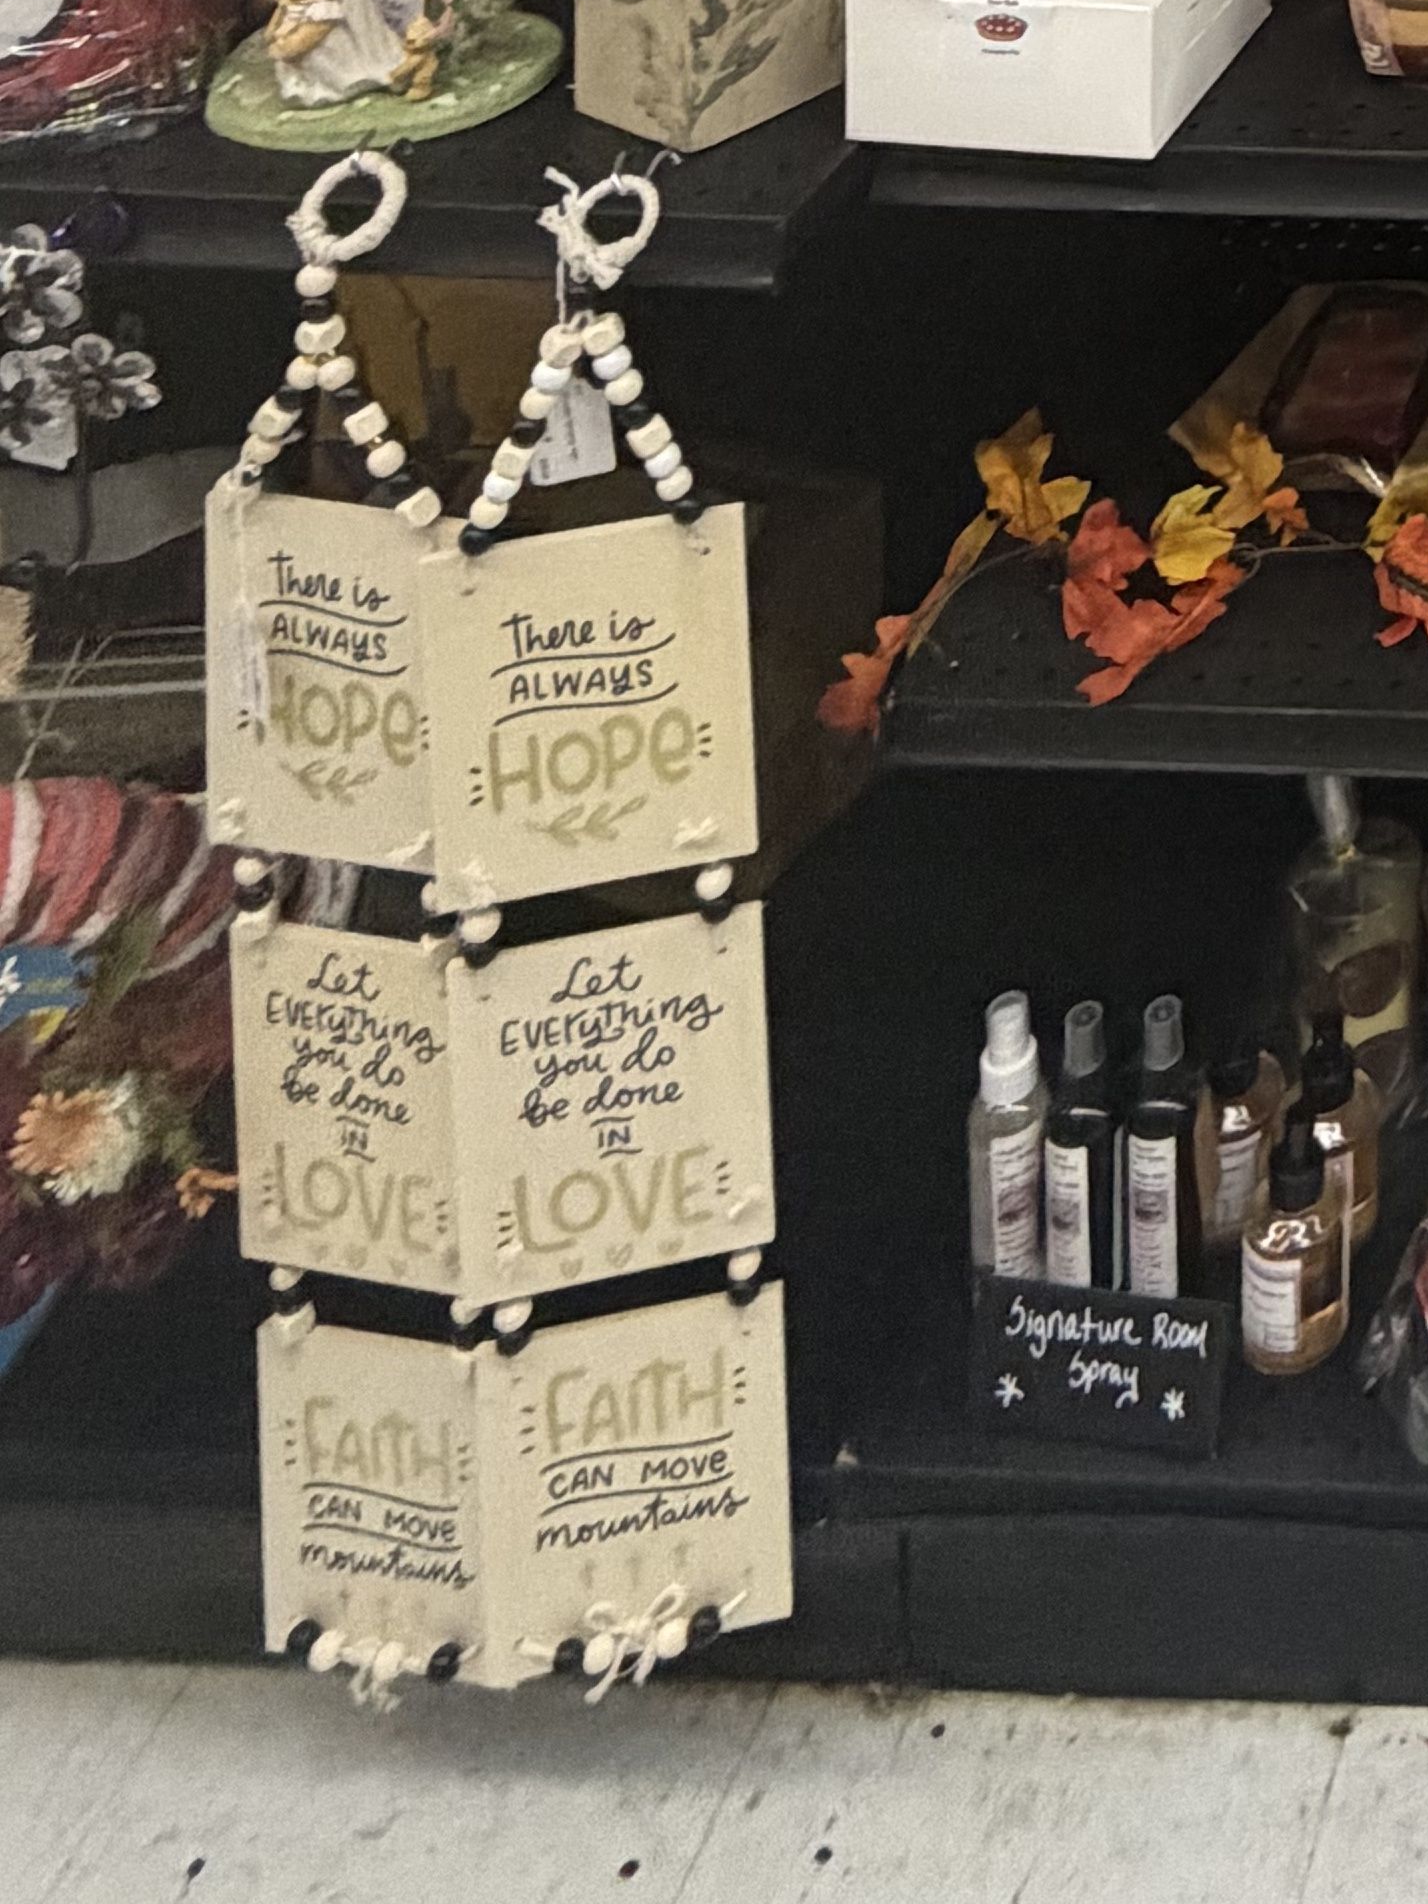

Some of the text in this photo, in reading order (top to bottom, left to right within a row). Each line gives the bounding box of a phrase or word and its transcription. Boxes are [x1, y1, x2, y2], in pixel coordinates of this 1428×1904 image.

[268, 550, 391, 610] There is
[271, 611, 388, 662] ALWAYS
[502, 610, 655, 661] There is
[510, 661, 653, 703] ALWAYS
[307, 953, 380, 1001] Let
[551, 953, 642, 1004] Let
[293, 1035, 405, 1087] you do
[535, 1030, 676, 1090] you do
[281, 1071, 412, 1125] be done
[519, 1079, 683, 1128] be done
[598, 1125, 631, 1149] IN
[275, 1142, 435, 1254] LOVE
[514, 1146, 713, 1253] LOVE
[1006, 1295, 1143, 1358] Signature
[544, 1349, 727, 1453] FAITH
[1068, 1354, 1140, 1408] Spray
[303, 1397, 452, 1485] FAITH
[548, 1463, 614, 1500] CAN
[307, 1496, 362, 1523] CAN
[535, 1491, 750, 1552] mountains
[300, 1541, 474, 1589] mountains
